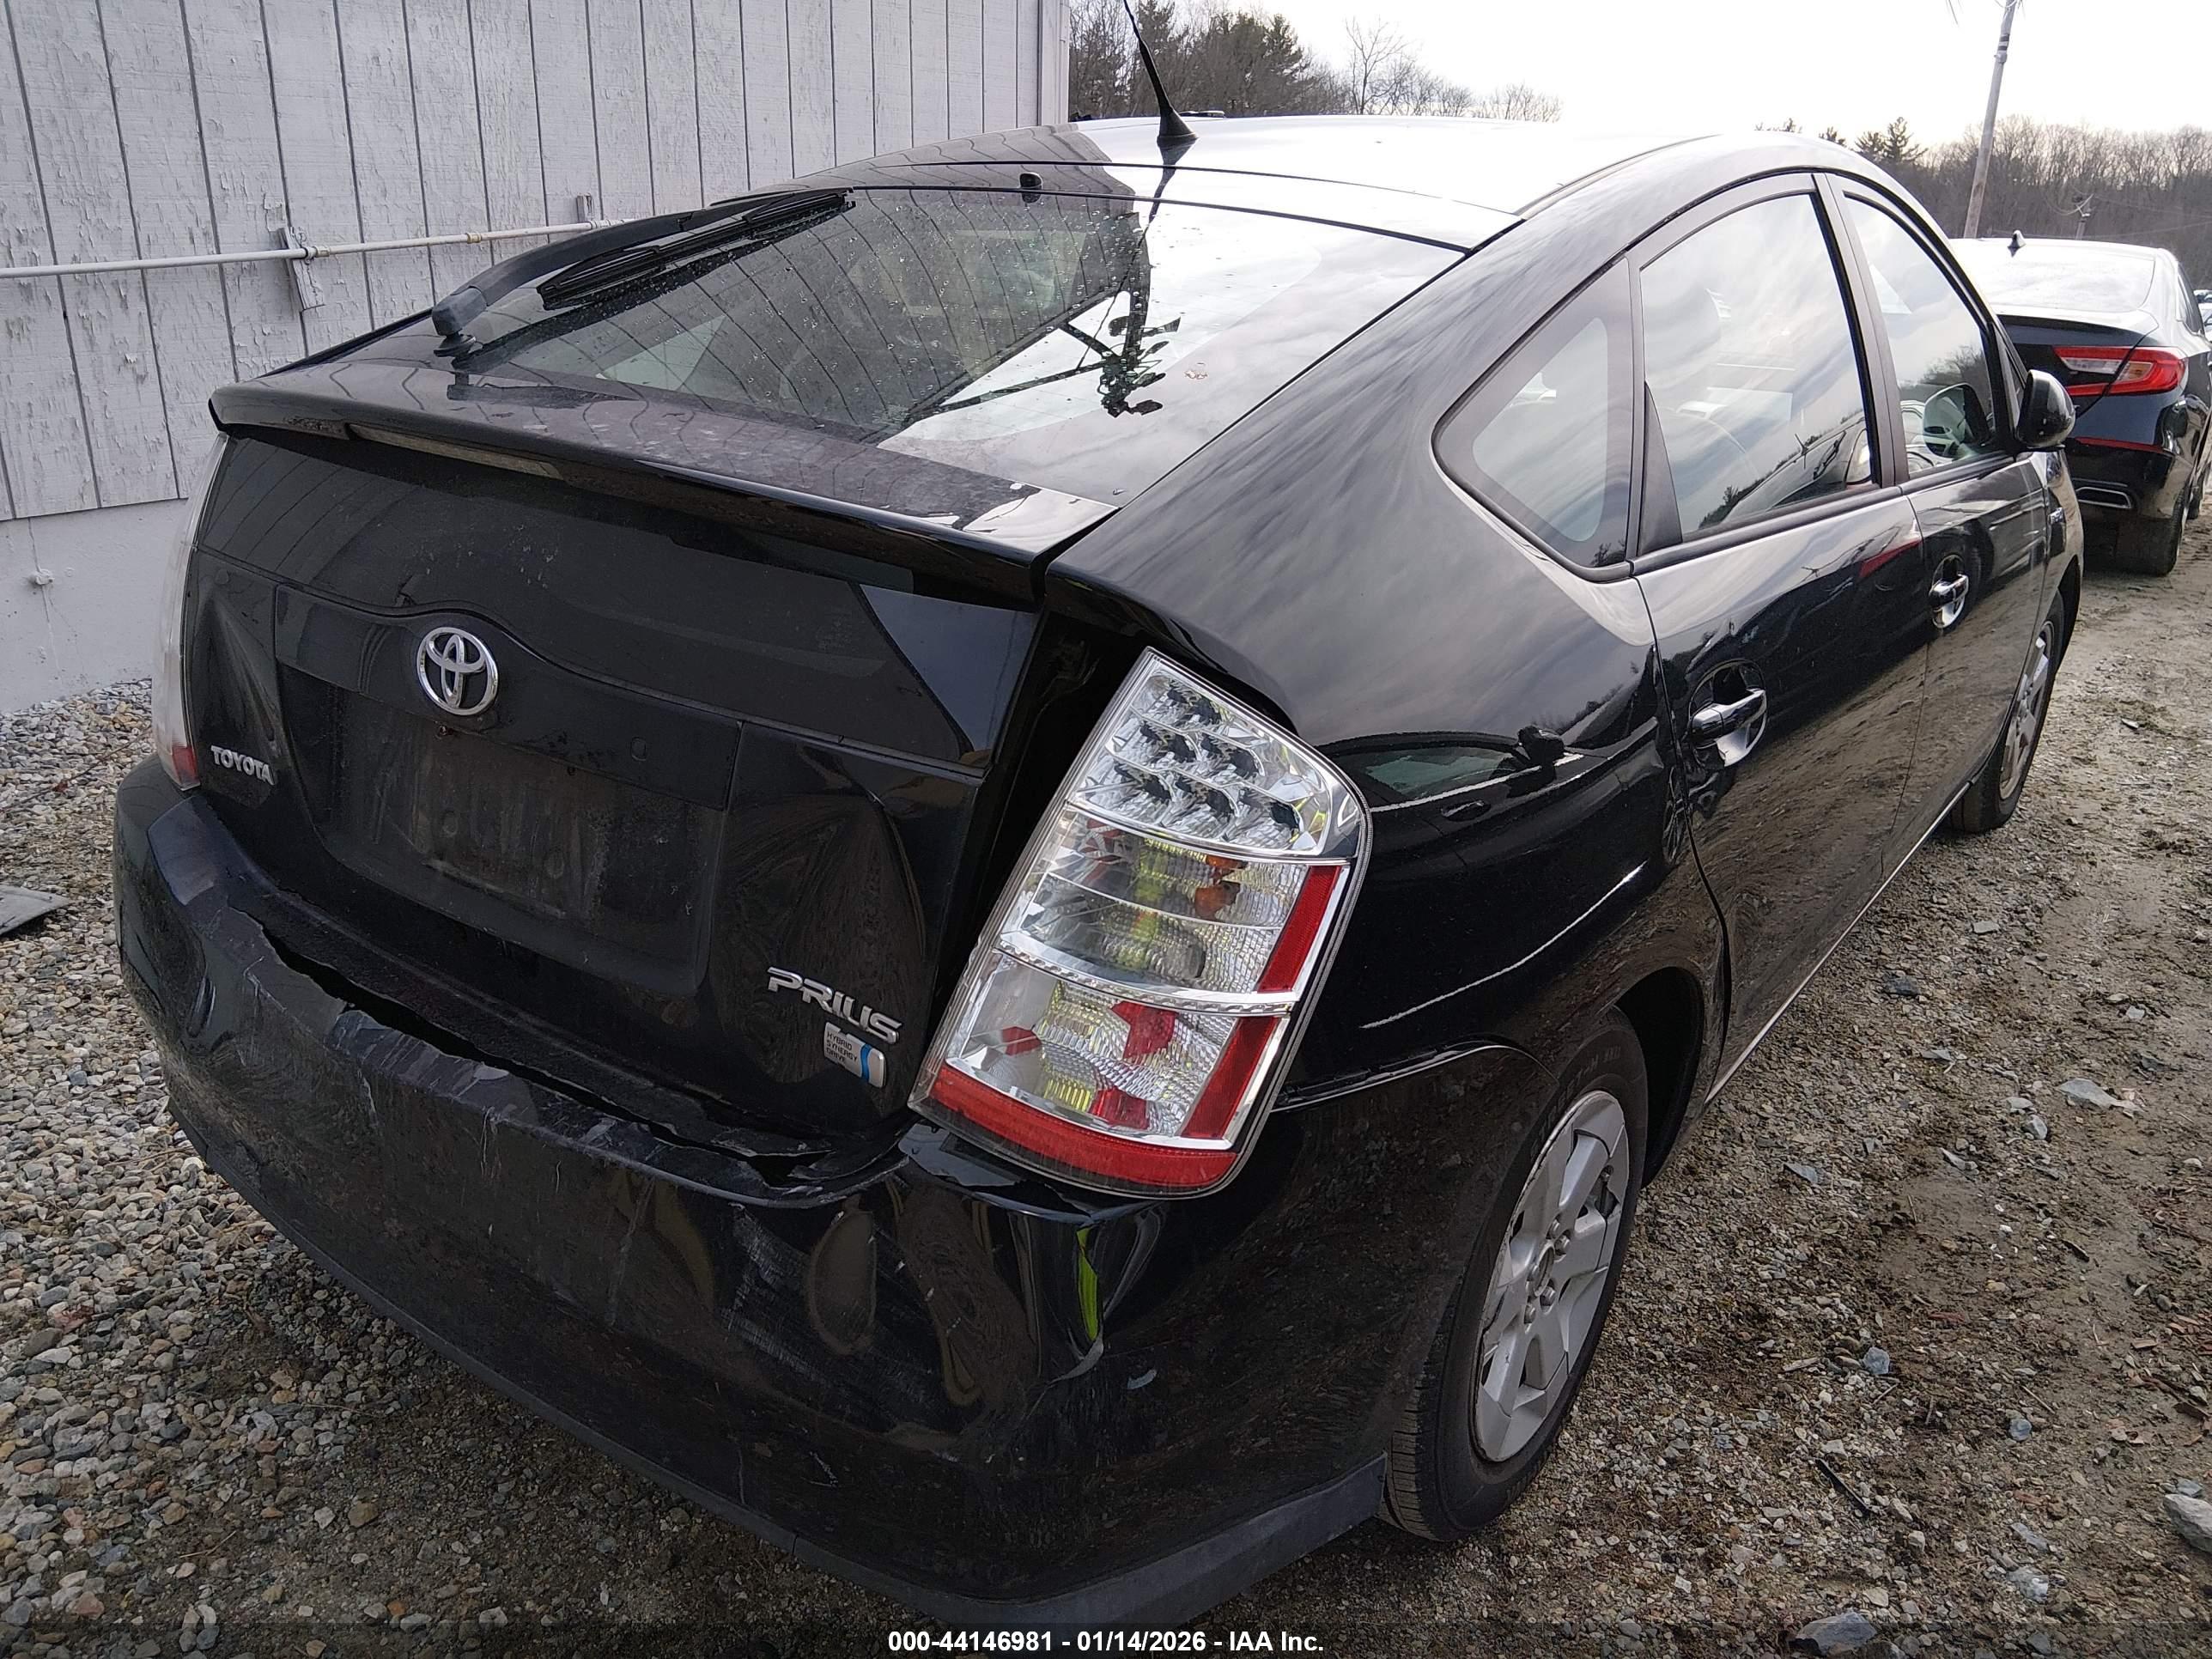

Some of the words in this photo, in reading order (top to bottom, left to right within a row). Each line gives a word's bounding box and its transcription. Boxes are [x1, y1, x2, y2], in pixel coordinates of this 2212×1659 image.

[210, 744, 276, 787] TOYOTA
[767, 966, 903, 1045] PRIUS
[826, 1031, 853, 1051] HYBRID
[826, 1040, 858, 1062] SYNERGY
[826, 1048, 845, 1062] DRIVE
